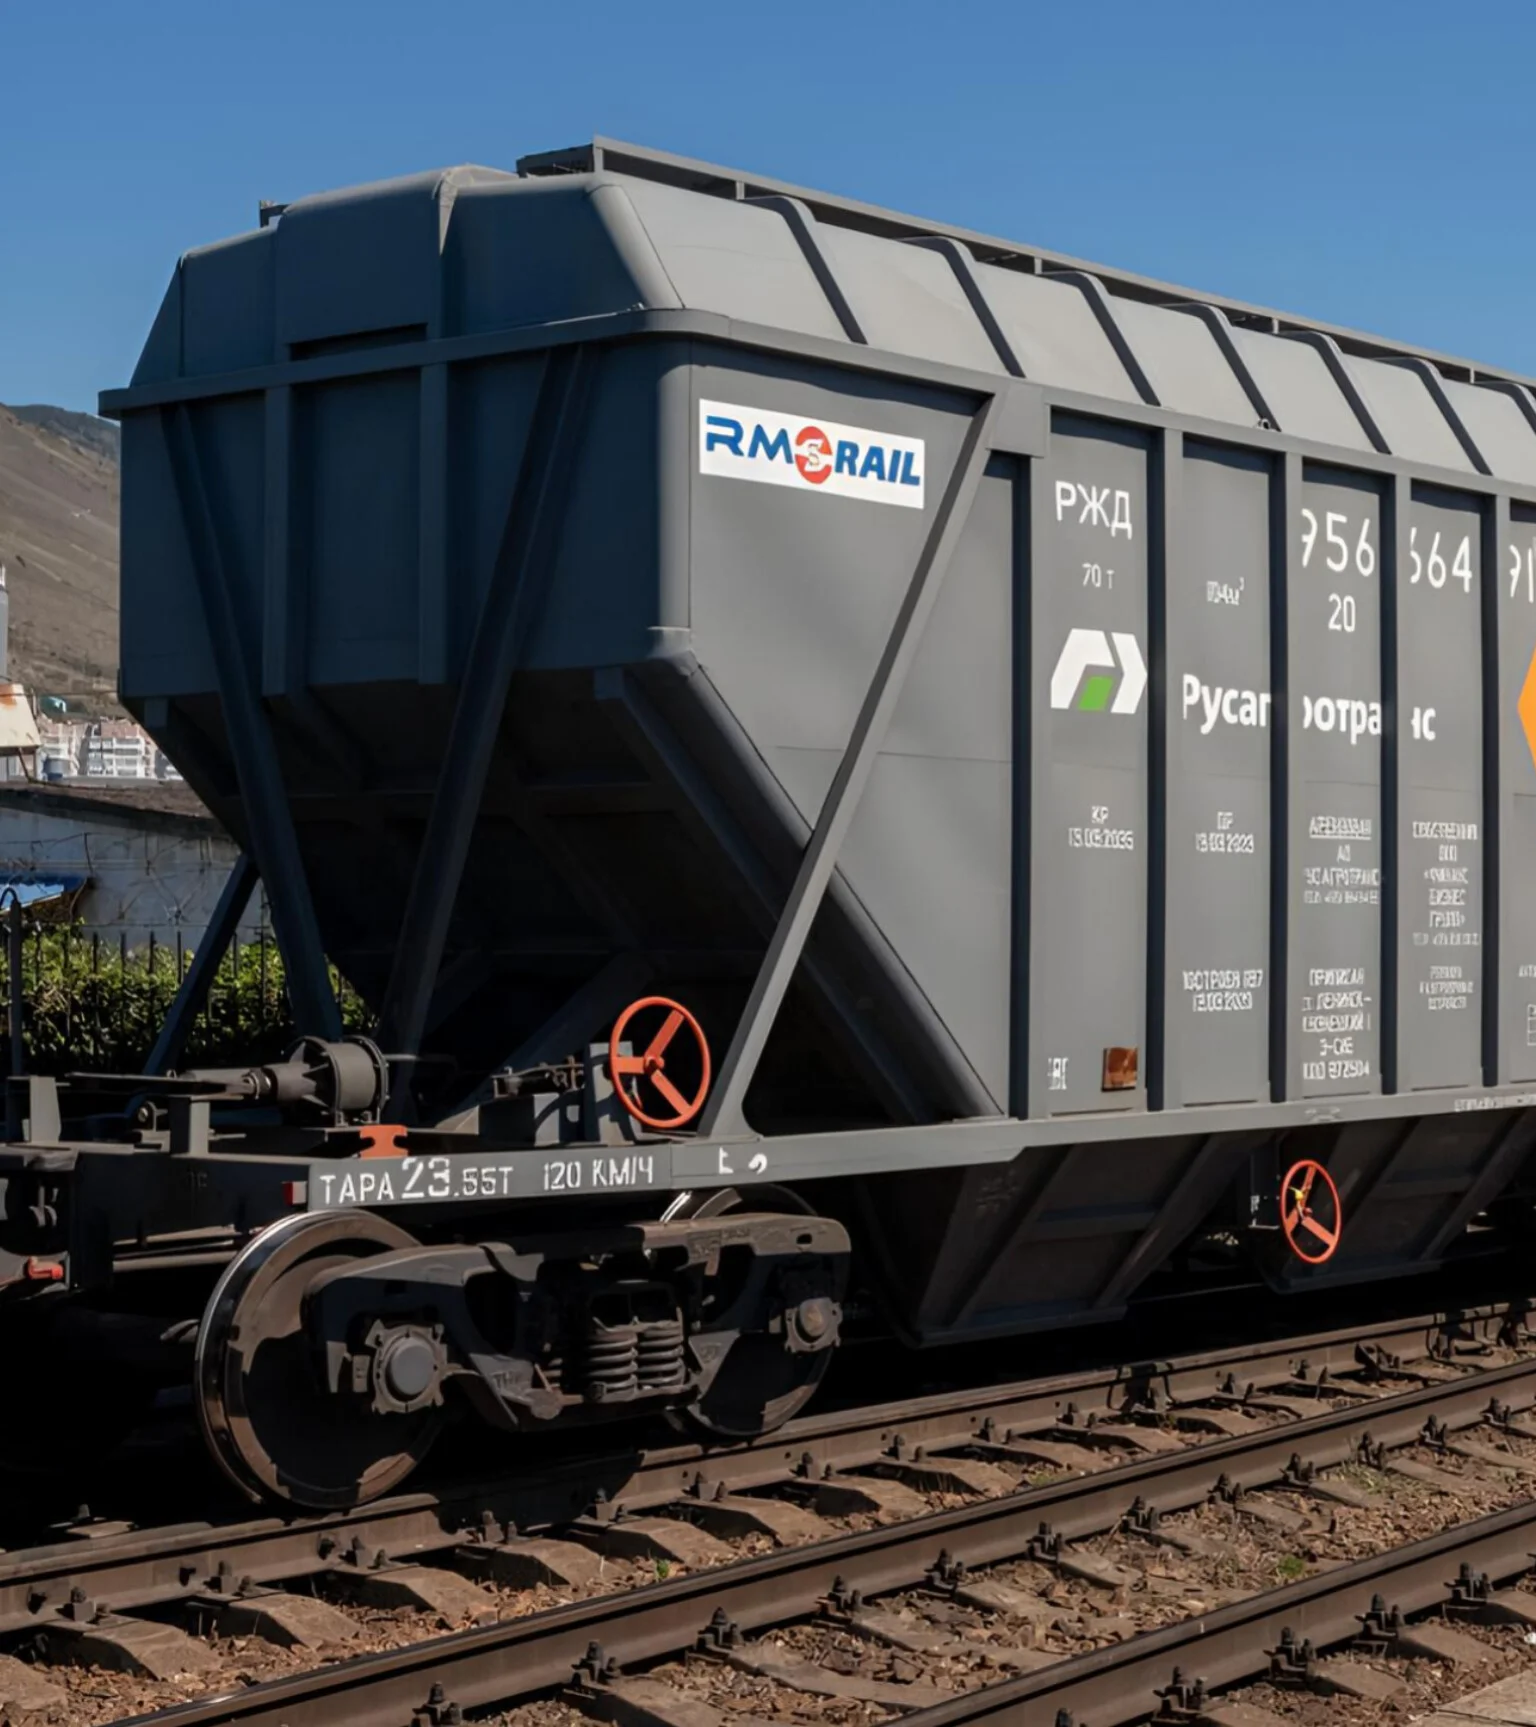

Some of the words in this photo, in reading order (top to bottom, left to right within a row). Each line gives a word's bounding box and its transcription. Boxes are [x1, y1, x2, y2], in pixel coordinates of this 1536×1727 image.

[1055, 480, 1133, 540] РЖД
[1082, 562, 1102, 588] 70
[1328, 593, 1356, 633] 20
[319, 1172, 395, 1205] ТАРА
[544, 1161, 581, 1191] 120
[592, 1155, 653, 1187] КМ/Ч
